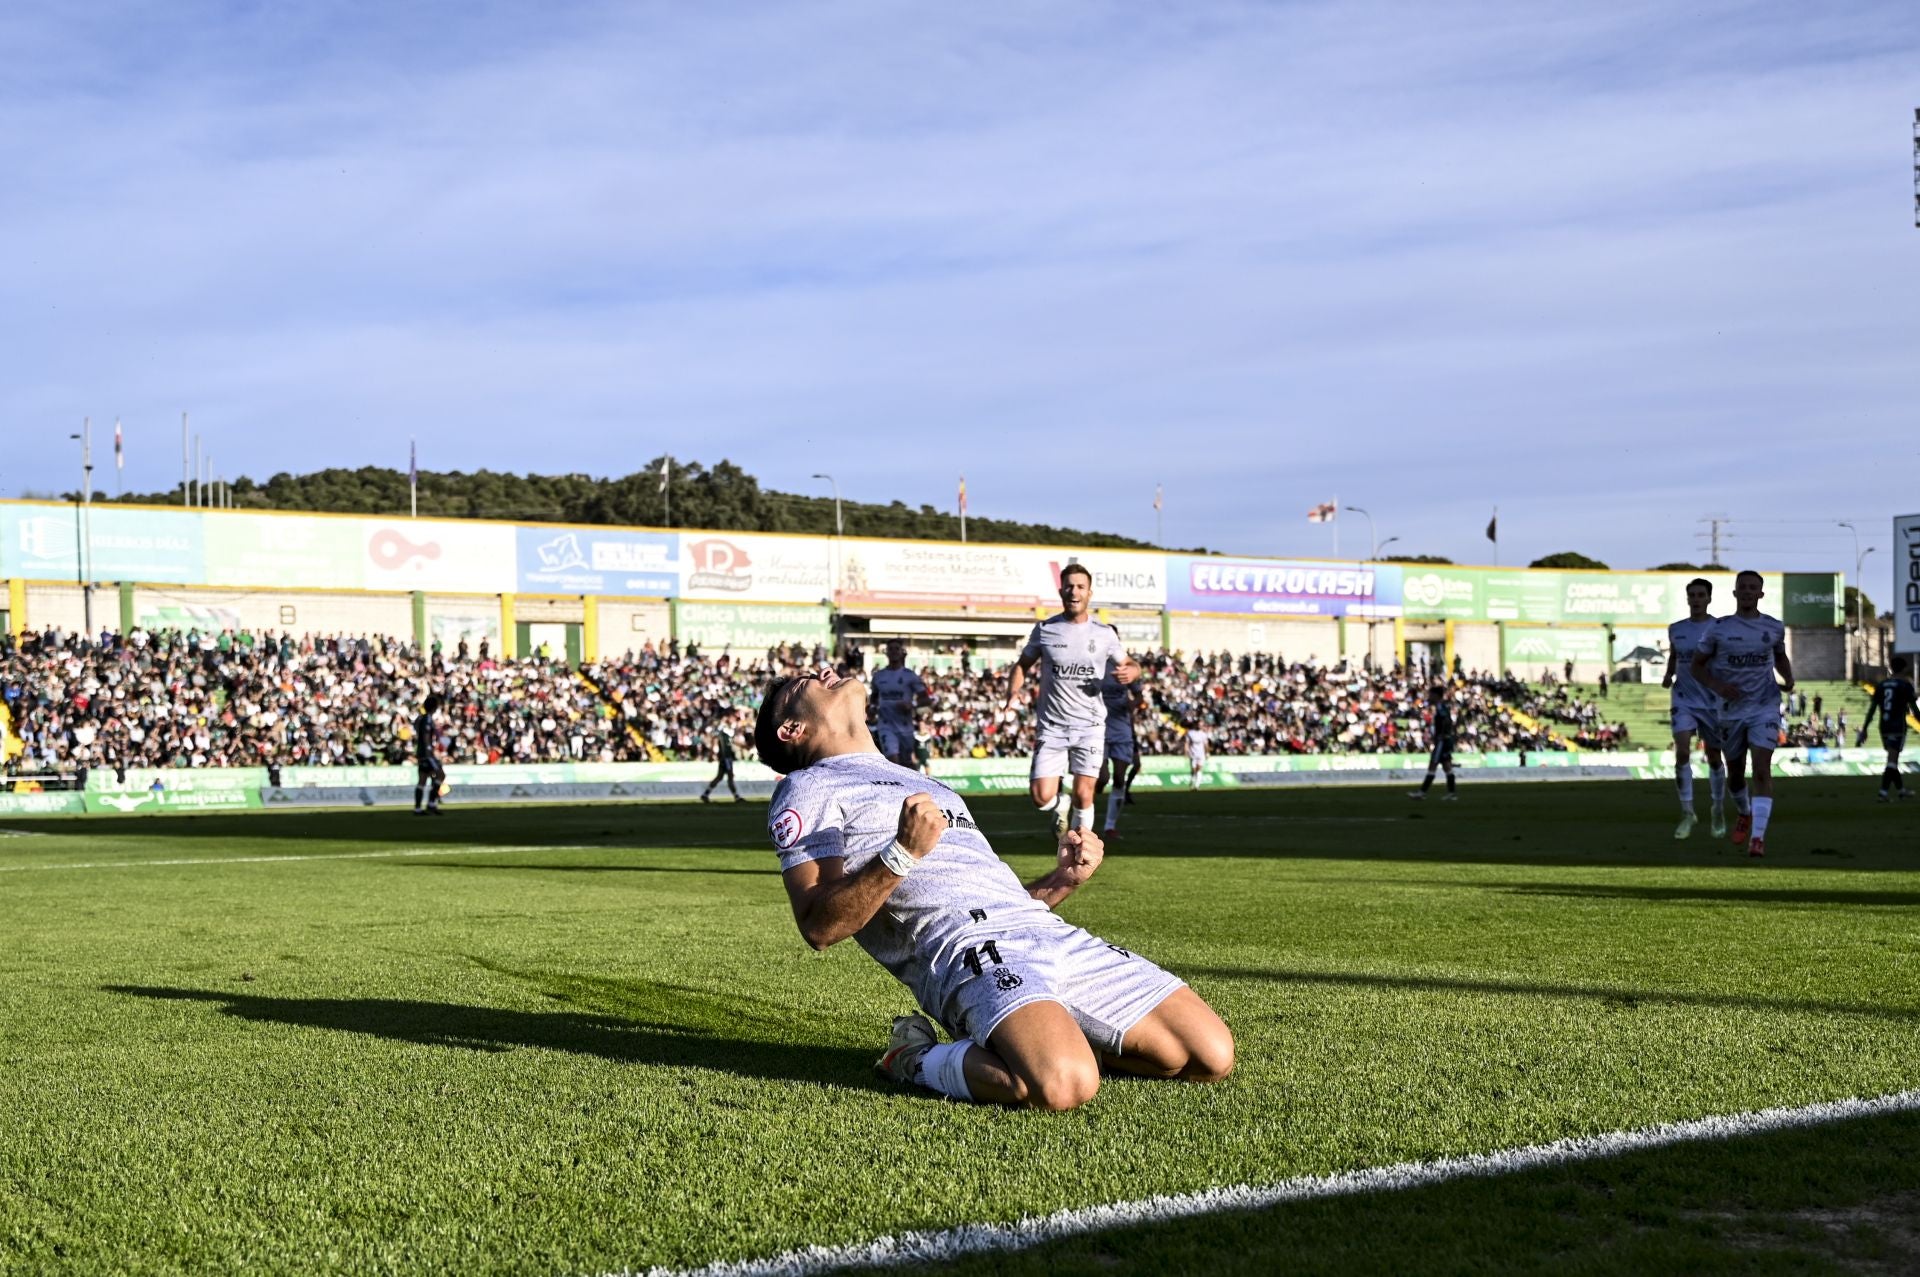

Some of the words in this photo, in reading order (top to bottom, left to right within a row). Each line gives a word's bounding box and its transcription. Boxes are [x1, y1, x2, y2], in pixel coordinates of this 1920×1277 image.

[902, 547, 960, 562] Sistemas
[965, 551, 1008, 564] Contra
[884, 561, 946, 575] Incendios
[1092, 570, 1157, 590] EHINCA
[1193, 563, 1374, 596] ELECTROCASH
[280, 605, 296, 625] B
[736, 606, 826, 624] Veterinaria
[963, 939, 1003, 976] 11
